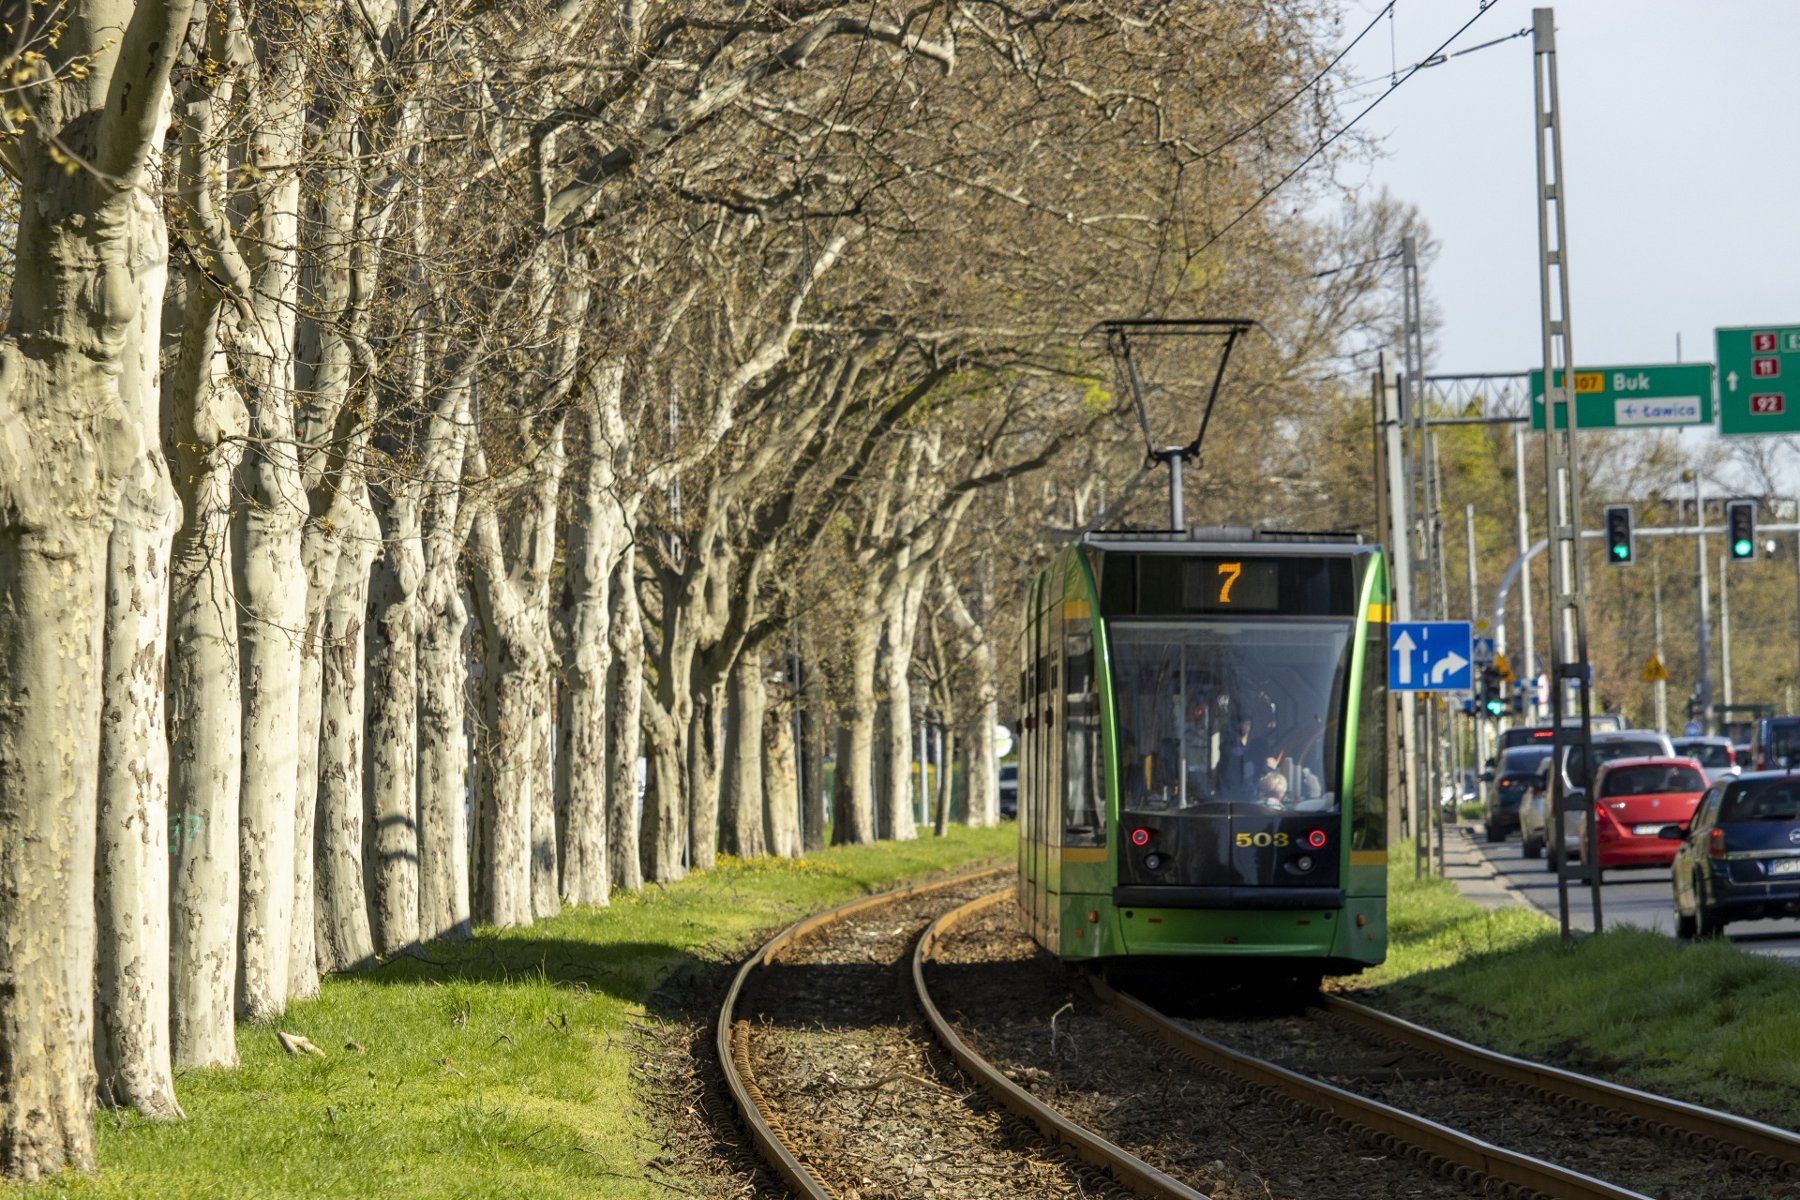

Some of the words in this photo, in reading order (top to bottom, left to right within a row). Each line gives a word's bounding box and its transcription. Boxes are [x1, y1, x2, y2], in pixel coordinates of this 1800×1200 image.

[1759, 335, 1771, 351] 5
[1758, 360, 1774, 375] 11
[1613, 372, 1650, 391] Buk
[1757, 396, 1778, 412] 92
[1217, 562, 1241, 603] 7
[1235, 832, 1289, 848] 503
